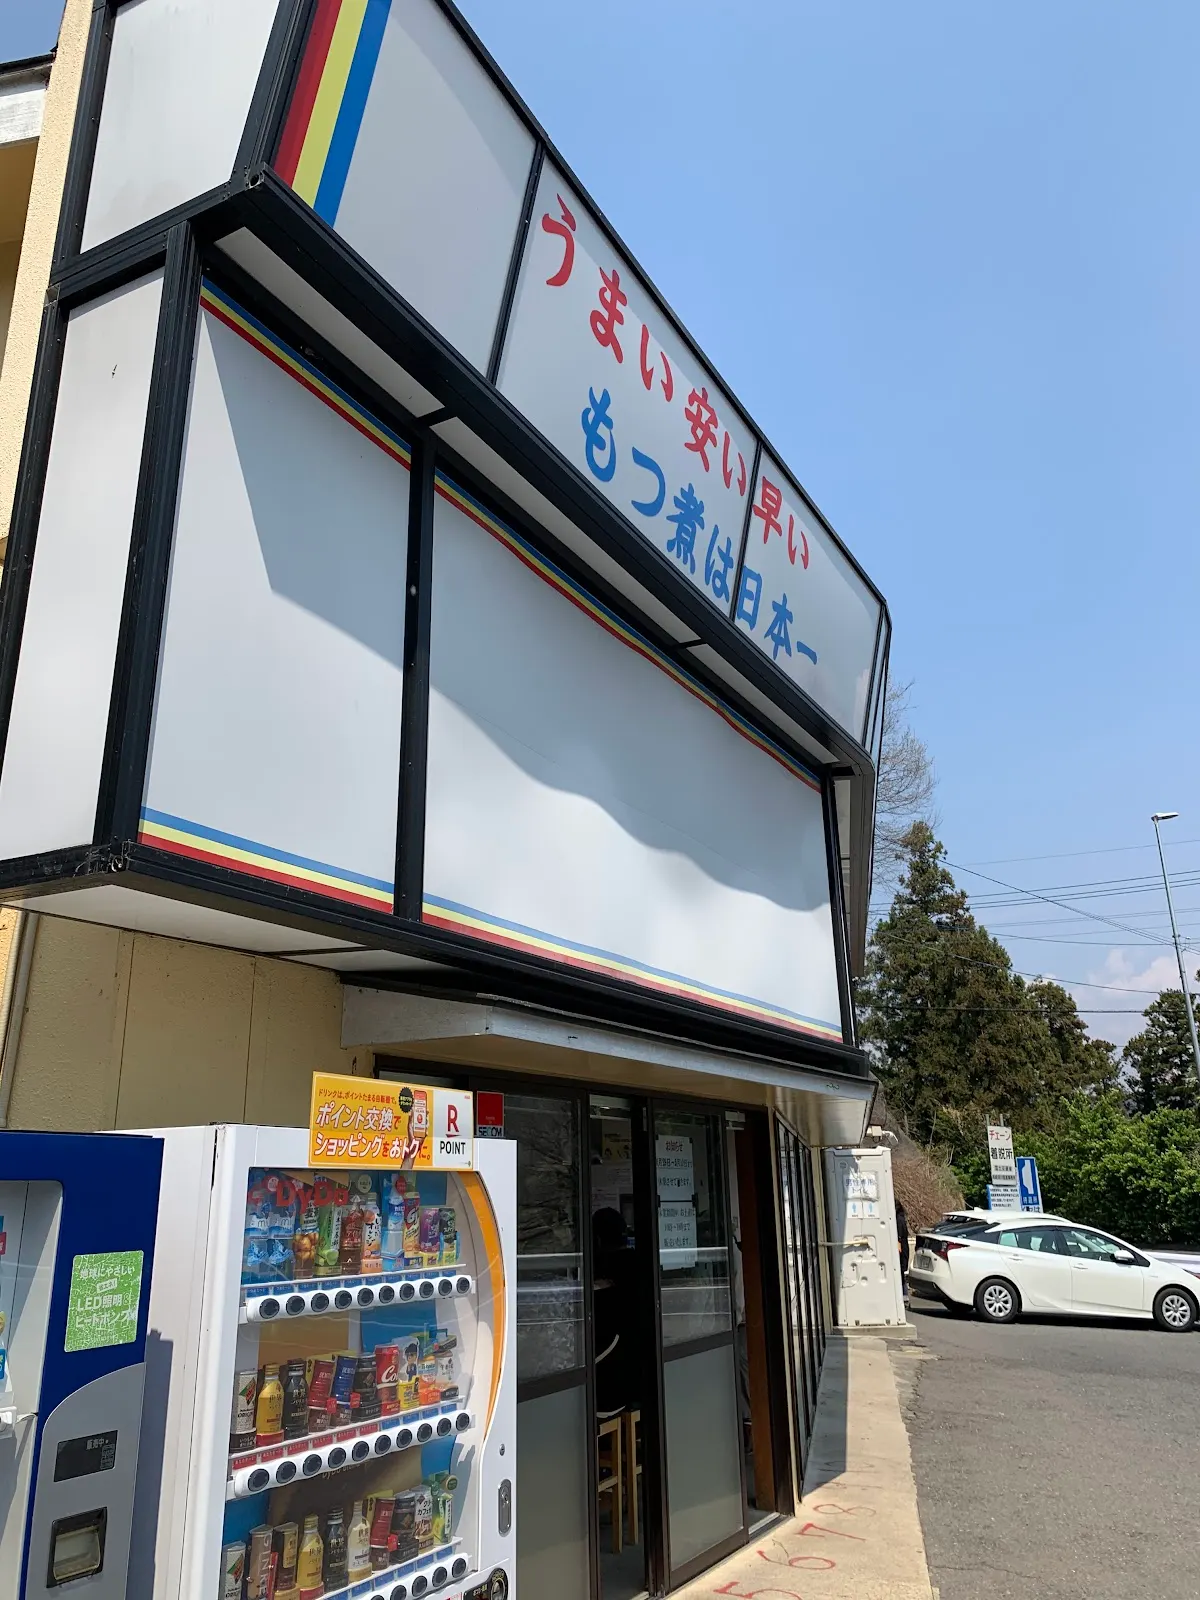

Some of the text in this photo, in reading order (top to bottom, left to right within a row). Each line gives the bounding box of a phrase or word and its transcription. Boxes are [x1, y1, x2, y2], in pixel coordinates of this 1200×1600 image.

[541, 193, 810, 570] うまい 安い 早い
[581, 385, 819, 666] もつ煮は日本一
[315, 1101, 402, 1132] ポイント交換で
[478, 1126, 503, 1137] SECOM
[439, 1140, 466, 1155] POINT
[276, 1180, 349, 1216] DyDo
